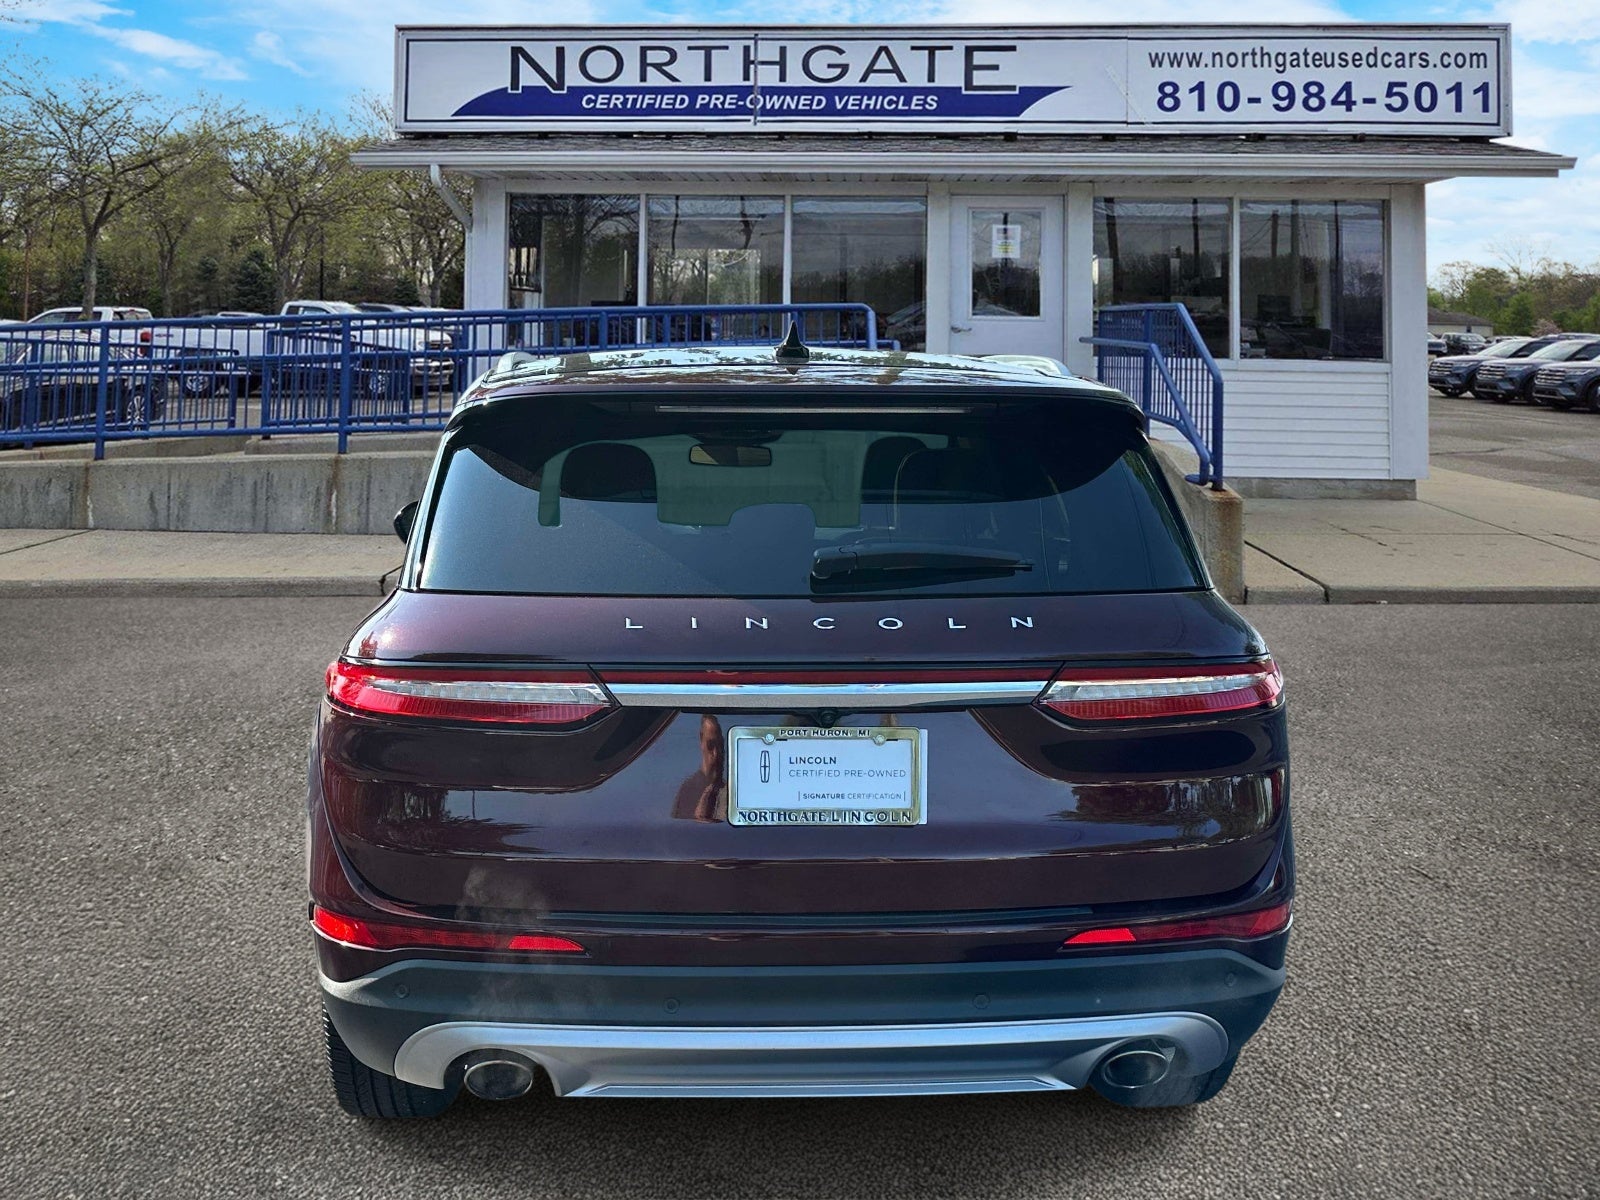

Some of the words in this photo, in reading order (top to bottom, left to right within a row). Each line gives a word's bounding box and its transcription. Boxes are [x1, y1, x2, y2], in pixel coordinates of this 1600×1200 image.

[1149, 46, 1488, 73] www.northgateusedcars.com
[510, 45, 1017, 91] NORTHGATE
[581, 94, 689, 109] CERTIFIED
[695, 94, 827, 110] PRE-OWNED
[834, 95, 938, 110] VEHICLES
[1156, 80, 1491, 113] 810-984-5011
[624, 615, 1034, 630] LINCOLN
[779, 729, 807, 737] PORT
[858, 729, 870, 737] MI
[788, 756, 837, 765] LINCOLN
[788, 769, 840, 778] CERTIFIED
[844, 769, 907, 778] PRE-OWNED
[737, 810, 827, 823] NORTHGATE
[831, 810, 912, 823] LINCOLN
